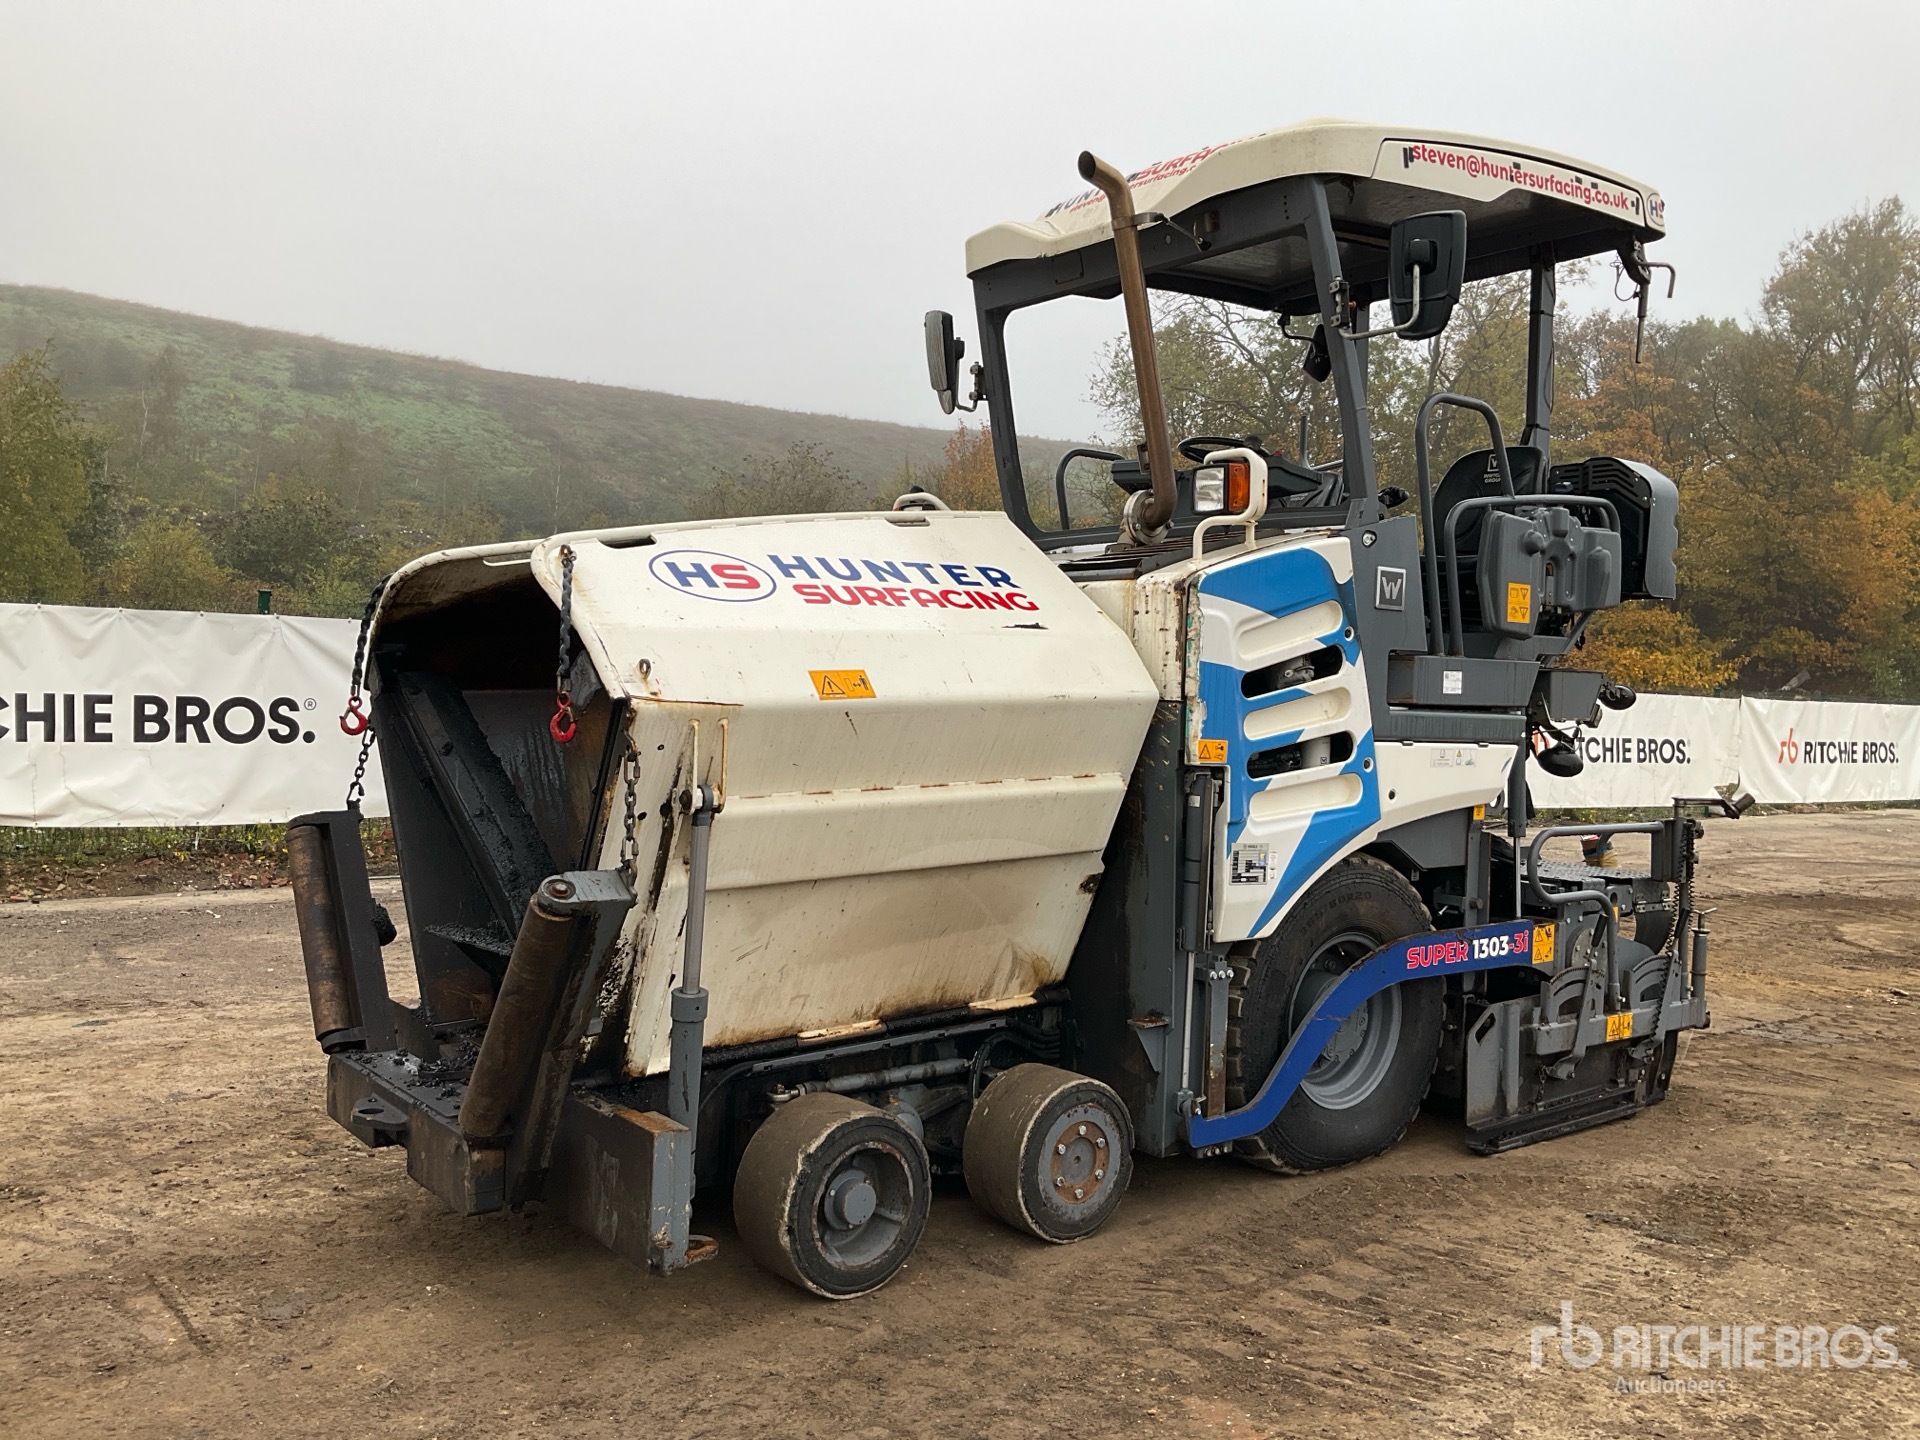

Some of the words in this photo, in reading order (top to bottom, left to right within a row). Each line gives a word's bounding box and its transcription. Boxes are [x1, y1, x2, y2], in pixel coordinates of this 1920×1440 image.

[1412, 144, 1629, 209] steven@huntersurfacing.co.uk
[663, 561, 761, 590] HS
[766, 554, 1022, 590] HUNTER
[792, 584, 1040, 611] SURFACING
[0, 692, 113, 743] HIE
[1636, 738, 1691, 764] BROS.
[1803, 741, 1858, 764] RITCHIE
[1862, 741, 1899, 764] BROS.
[1407, 941, 1469, 969] SUPER
[1472, 930, 1529, 960] 1303-3i
